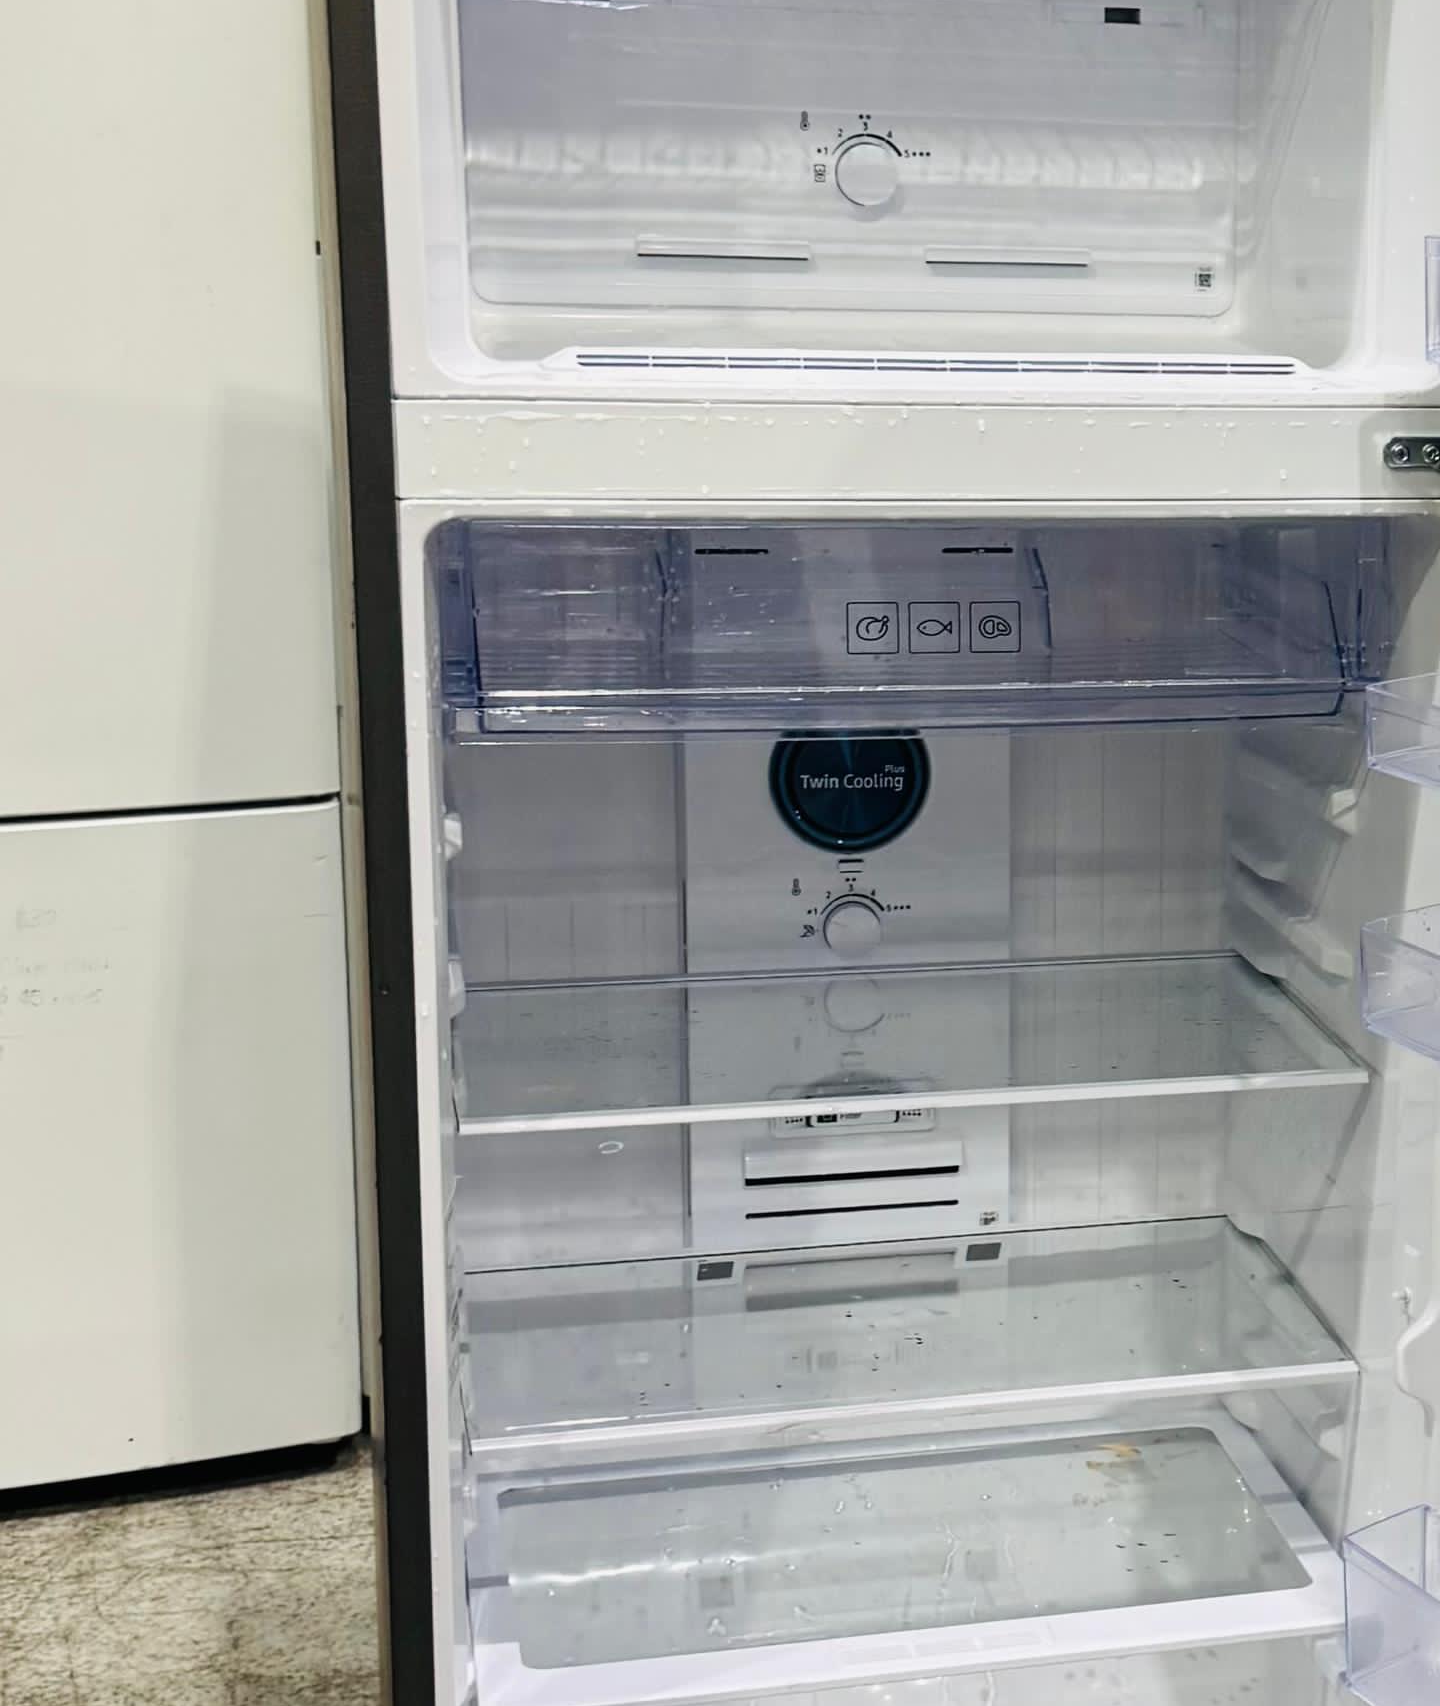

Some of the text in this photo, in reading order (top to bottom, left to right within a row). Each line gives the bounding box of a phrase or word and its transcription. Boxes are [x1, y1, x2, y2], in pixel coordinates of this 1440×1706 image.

[884, 764, 905, 773] Plus
[799, 773, 904, 791] Twin Cooling
